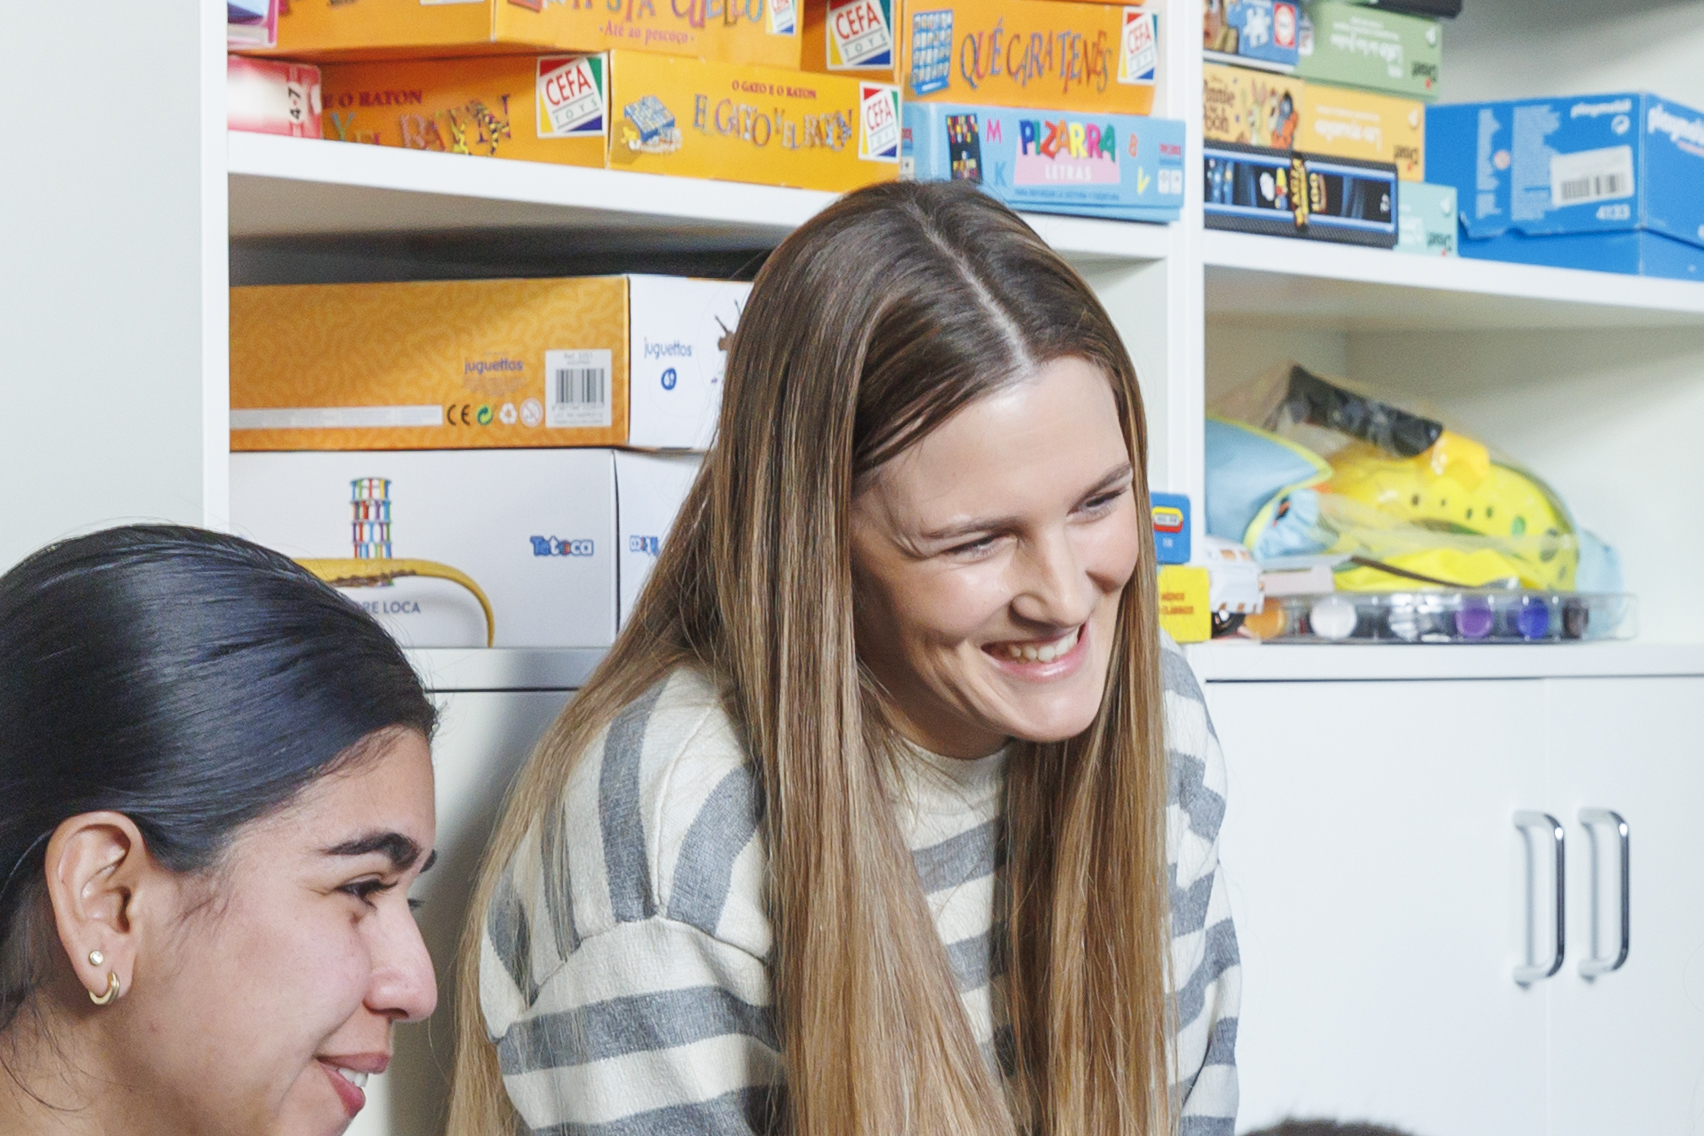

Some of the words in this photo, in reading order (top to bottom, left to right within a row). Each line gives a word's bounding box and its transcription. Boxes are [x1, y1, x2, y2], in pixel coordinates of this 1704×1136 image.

[835, 1, 881, 41] CEFA
[844, 33, 886, 58] TOYS
[1006, 30, 1055, 87] CARA
[545, 65, 592, 106] CEFA
[555, 97, 597, 124] TOYS
[714, 98, 772, 148] GATO
[866, 96, 893, 131] CEFA
[1019, 119, 1116, 163] PIZARRA
[1045, 164, 1092, 181] LETRAS
[383, 601, 421, 614] LOCA
